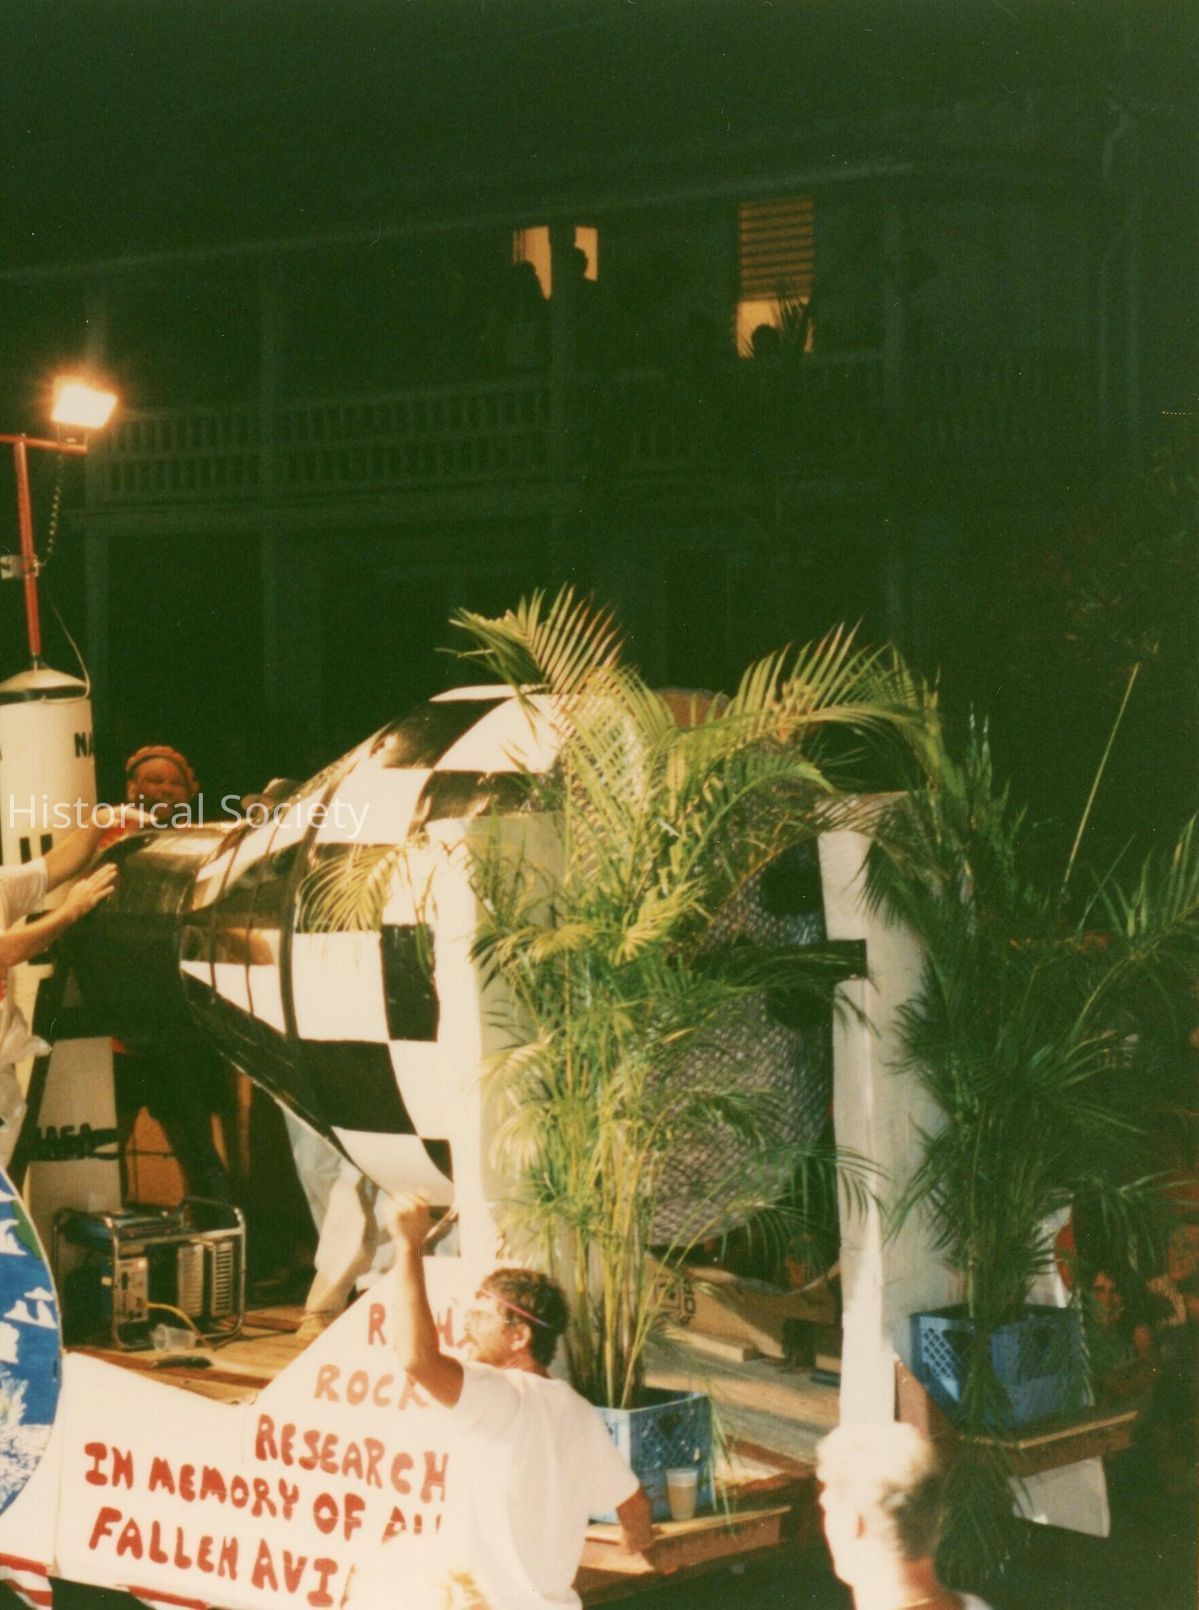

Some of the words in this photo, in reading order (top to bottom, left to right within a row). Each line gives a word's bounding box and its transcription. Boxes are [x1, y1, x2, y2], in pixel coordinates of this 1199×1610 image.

[83, 1442, 135, 1490] IN
[148, 1456, 300, 1521] MEMORY
[312, 1492, 366, 1542] OF
[254, 1413, 449, 1504] RESEARCH
[88, 1506, 240, 1581] FALLEN
